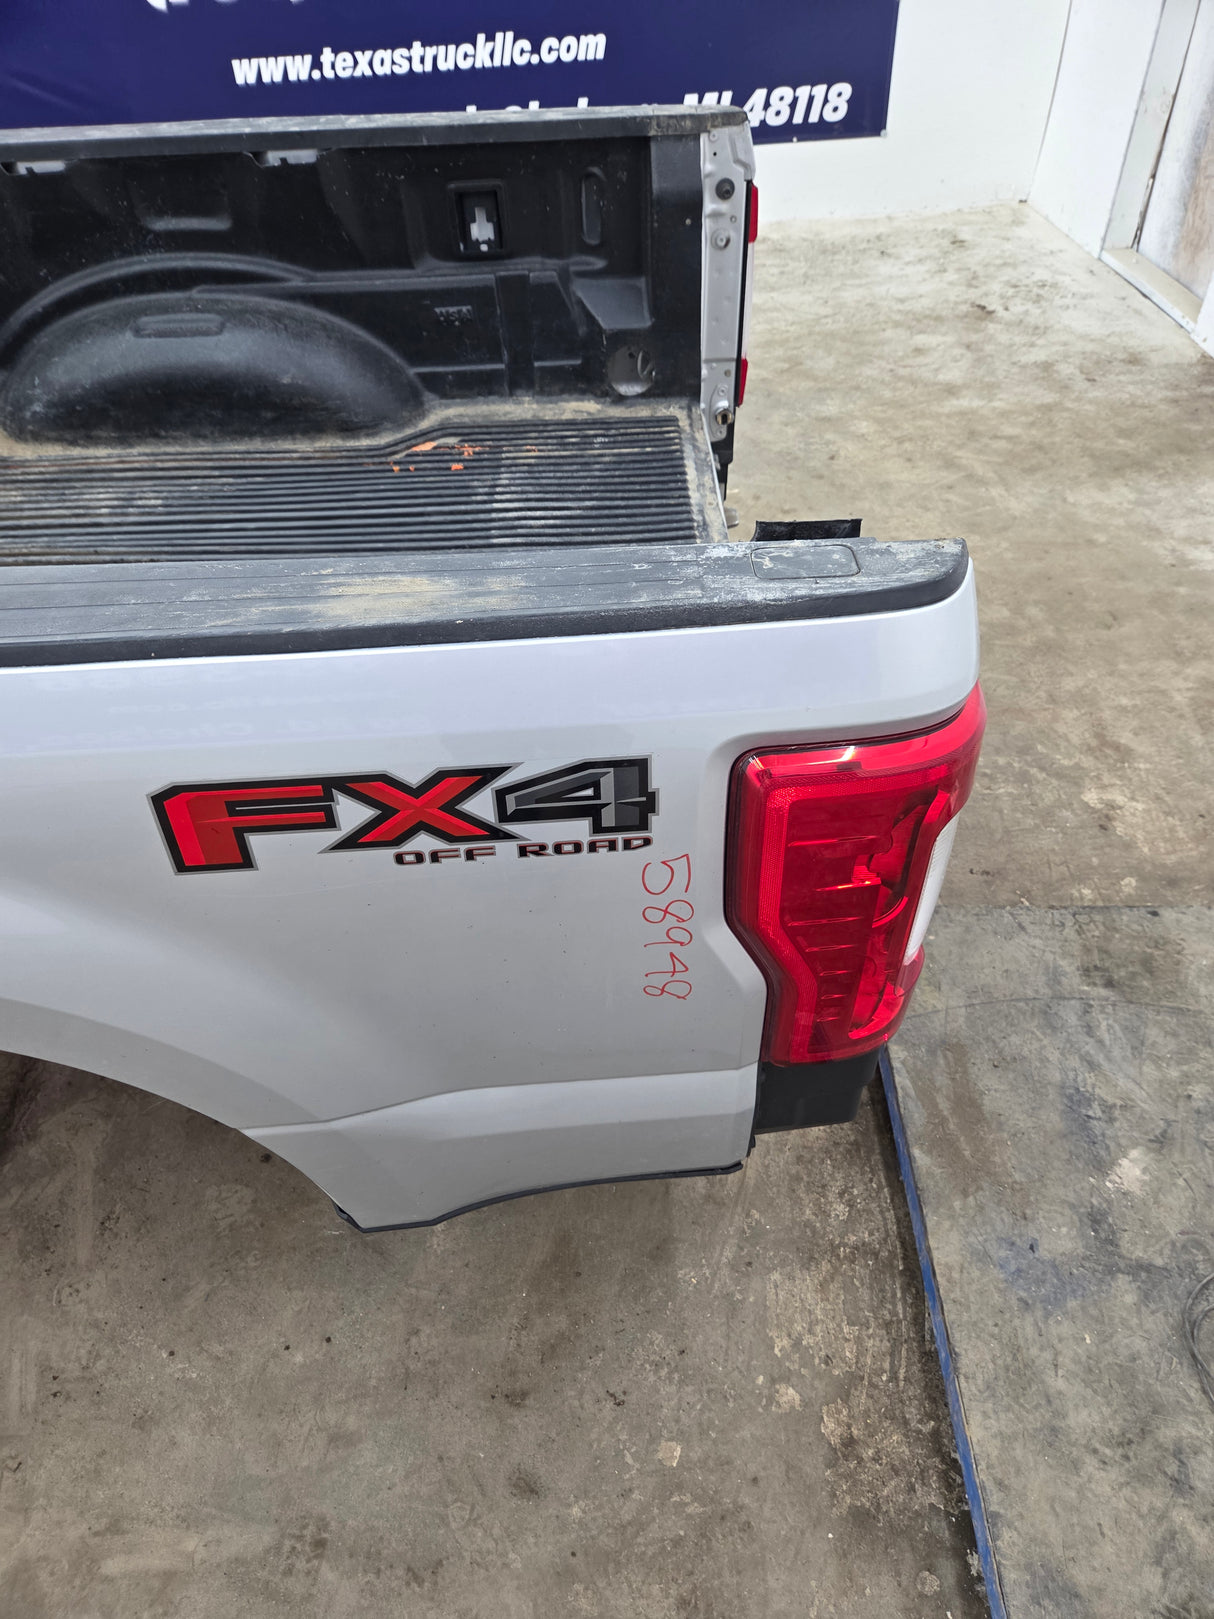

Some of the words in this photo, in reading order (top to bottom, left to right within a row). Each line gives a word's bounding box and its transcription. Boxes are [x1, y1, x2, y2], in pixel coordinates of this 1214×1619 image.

[231, 30, 607, 86] www.texastruckllc.com
[743, 81, 853, 128] 48118
[147, 754, 660, 875] FX4
[394, 843, 497, 866] OFF
[517, 835, 653, 859] ROAD
[641, 853, 695, 1001] 58948
